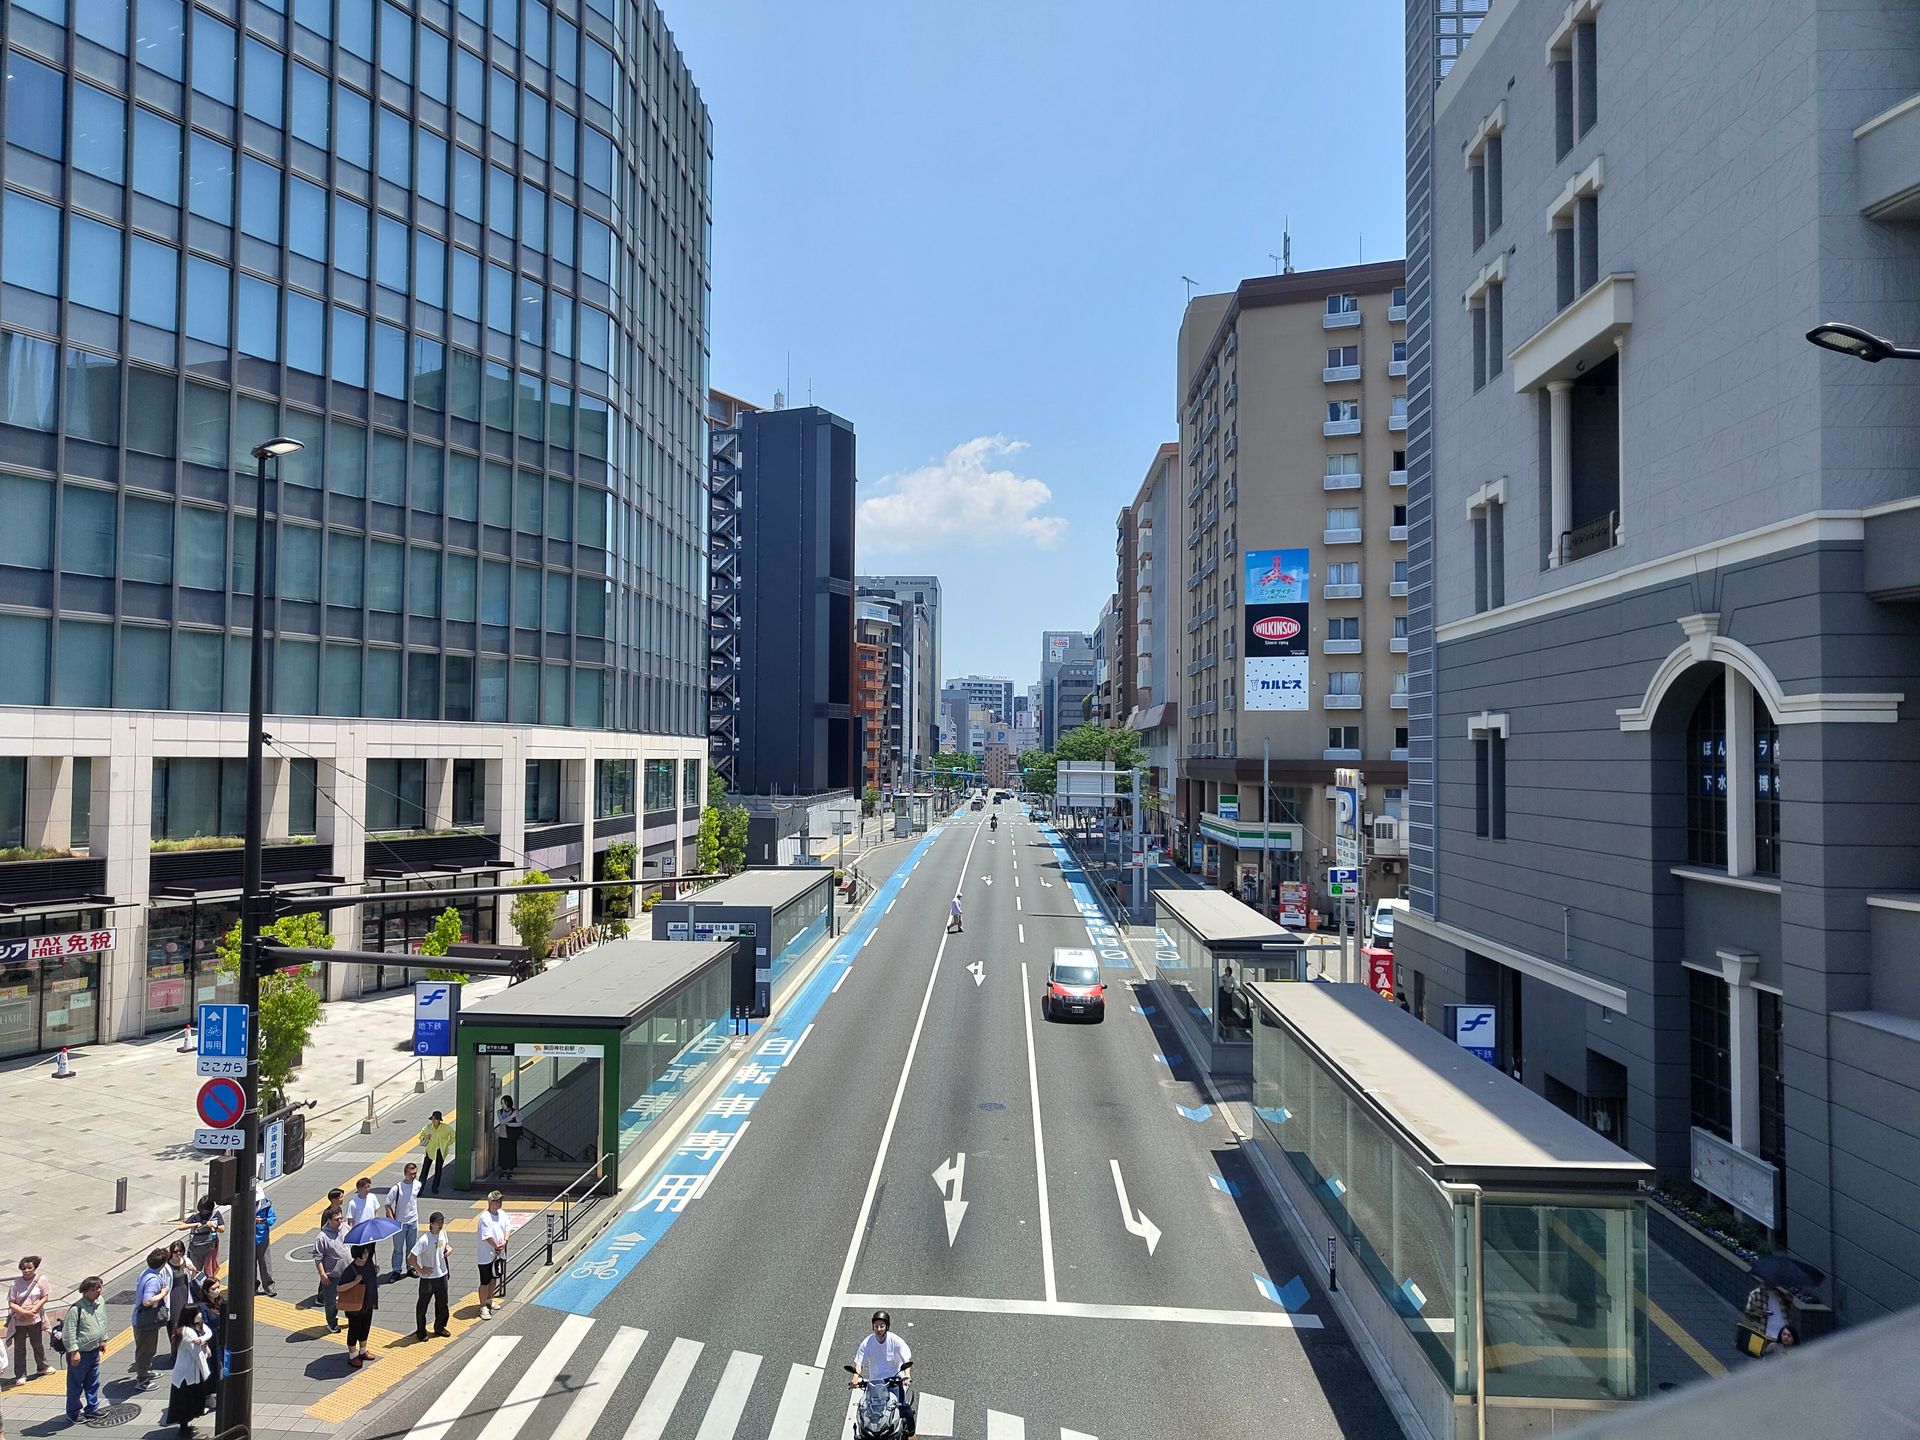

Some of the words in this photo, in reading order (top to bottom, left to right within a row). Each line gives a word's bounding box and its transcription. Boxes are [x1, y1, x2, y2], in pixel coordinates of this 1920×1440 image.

[1255, 621, 1298, 636] WILKINSON
[1260, 679, 1302, 690] カルピス
[664, 857, 672, 865] P
[1336, 870, 1350, 883] P
[33, 936, 61, 948] TAX
[66, 931, 112, 954] 免税
[32, 945, 64, 958] FREE
[417, 1021, 442, 1030] 地下鉄
[205, 1040, 222, 1050] 専用
[200, 1061, 243, 1073] ここから
[628, 1036, 795, 1213] 自転車専用
[198, 1134, 241, 1146] ここから
